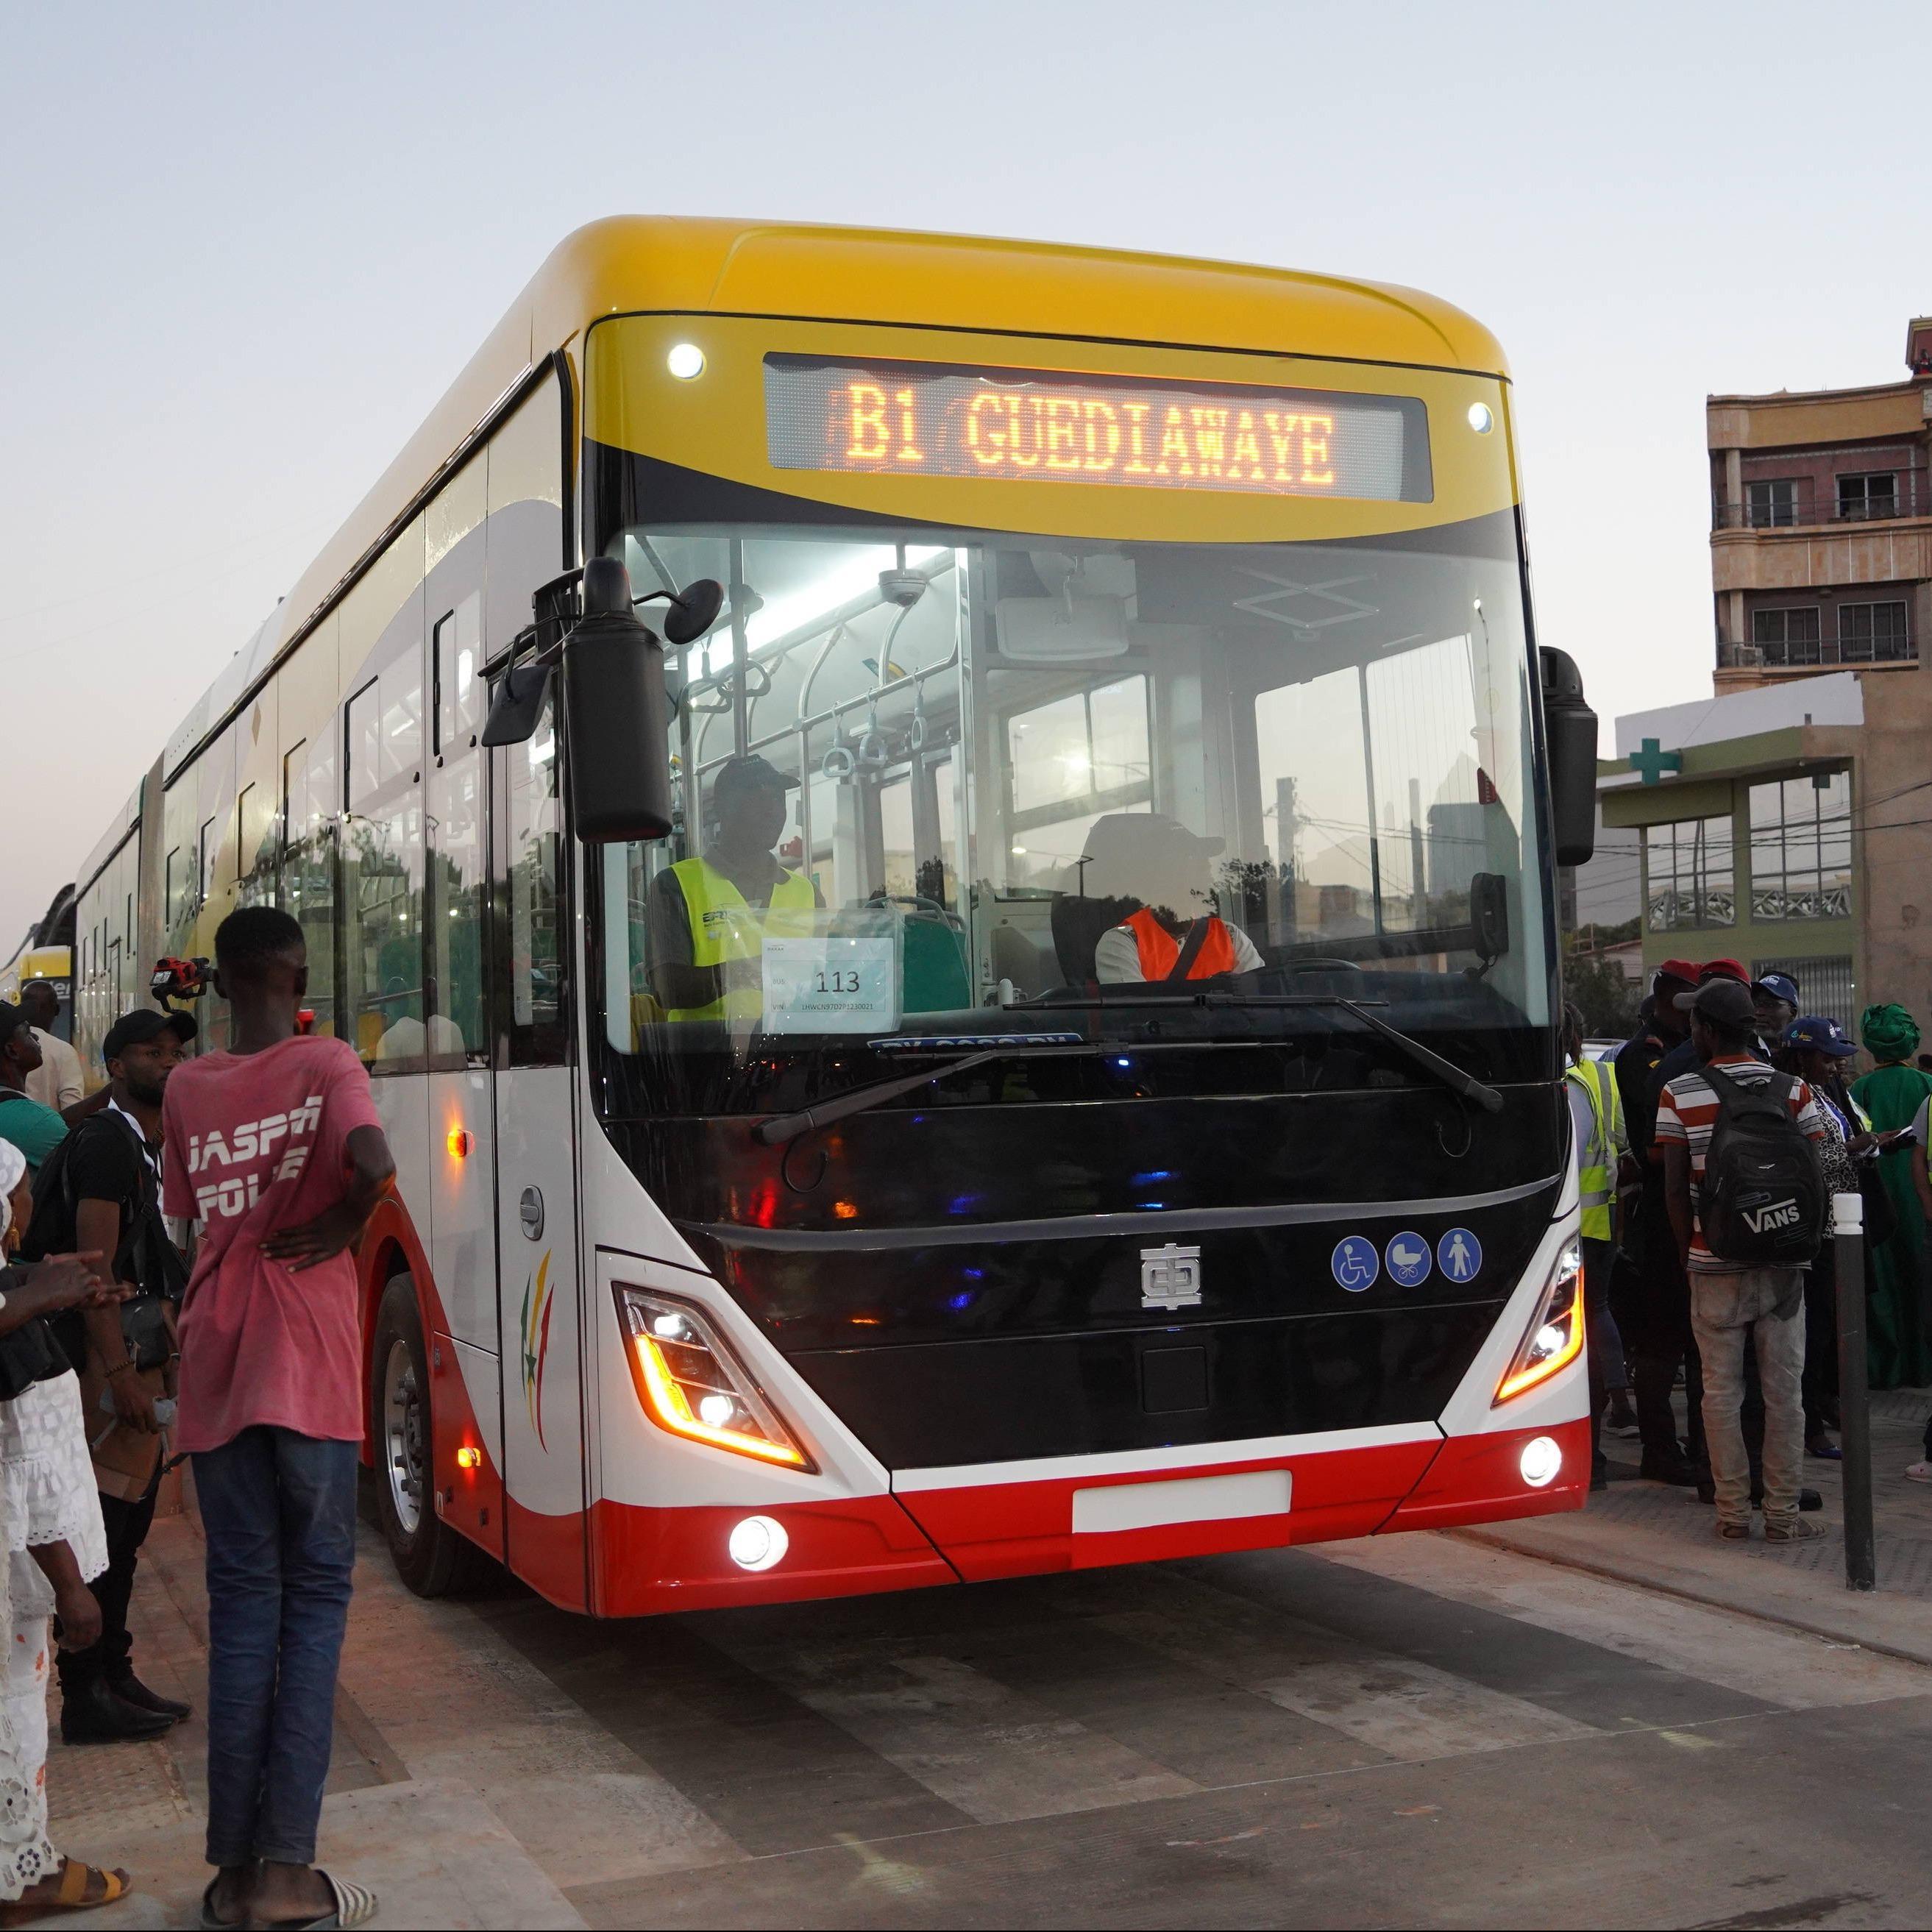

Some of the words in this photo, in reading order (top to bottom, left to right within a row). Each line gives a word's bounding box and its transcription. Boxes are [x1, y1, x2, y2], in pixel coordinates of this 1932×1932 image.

[846, 384, 924, 462] B1
[967, 391, 1335, 485] GUEDIAWAYE
[816, 971, 860, 992] 113
[1741, 1198, 1800, 1234] VANS
